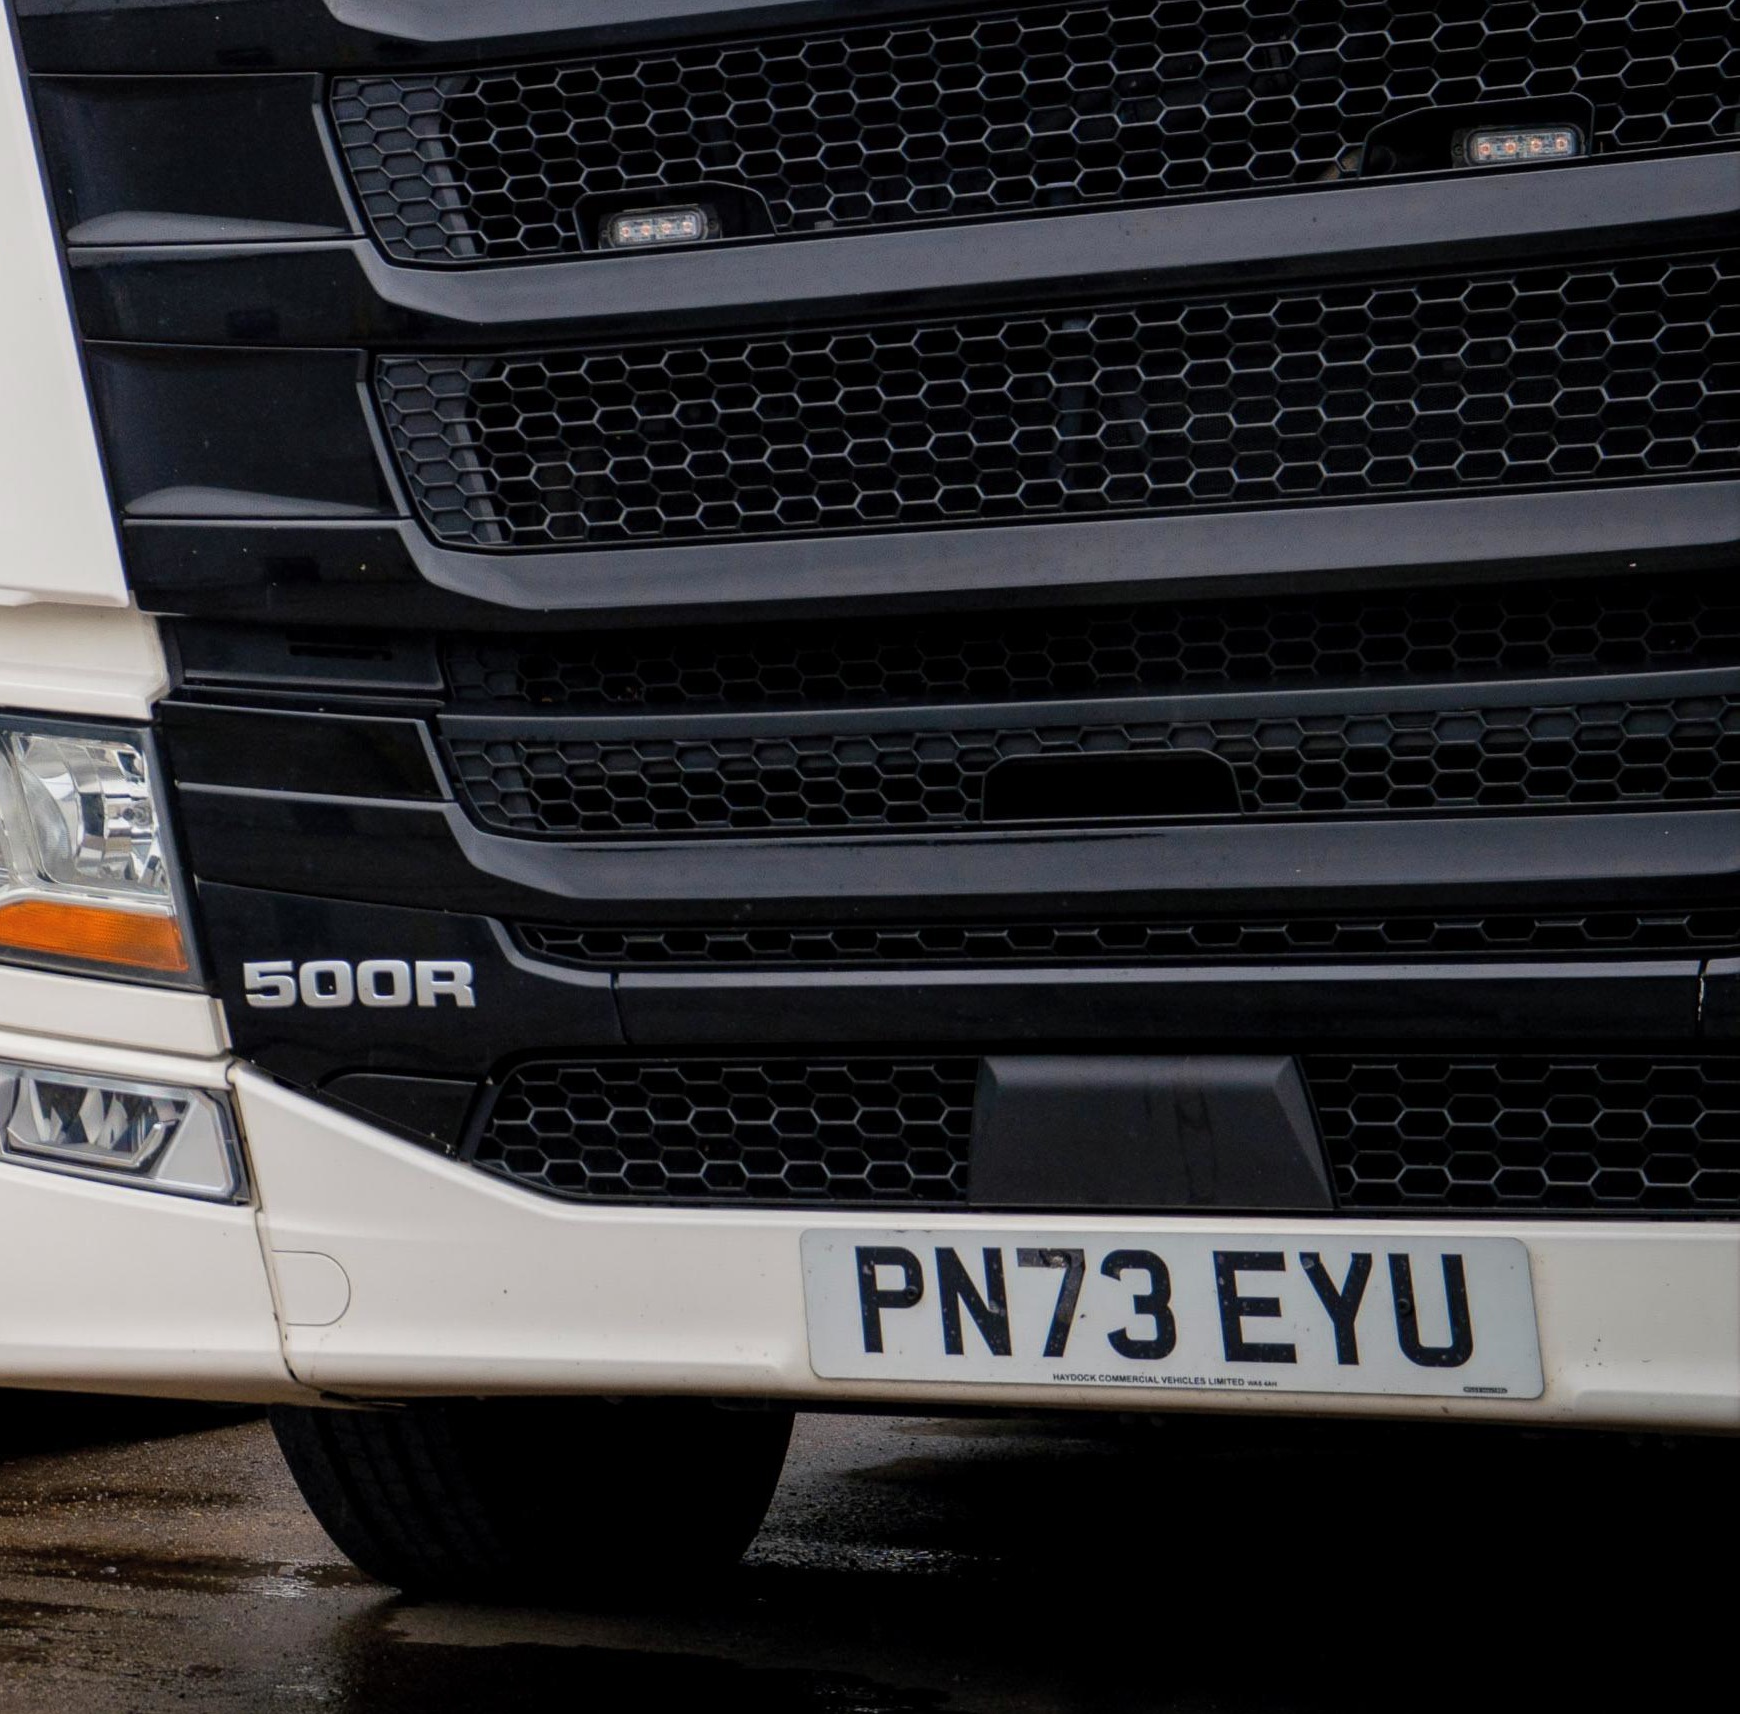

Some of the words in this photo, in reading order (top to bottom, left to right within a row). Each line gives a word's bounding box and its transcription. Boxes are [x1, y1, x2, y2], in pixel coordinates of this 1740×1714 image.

[243, 959, 476, 1008] 500R
[854, 1244, 1178, 1360] PN73
[1212, 1250, 1475, 1368] EYU
[1053, 1373, 1097, 1382] HAYDOCK
[1098, 1374, 1159, 1384] COMMERCIAL
[1161, 1376, 1206, 1385] VEHICLES
[1208, 1377, 1244, 1387] LIMITED
